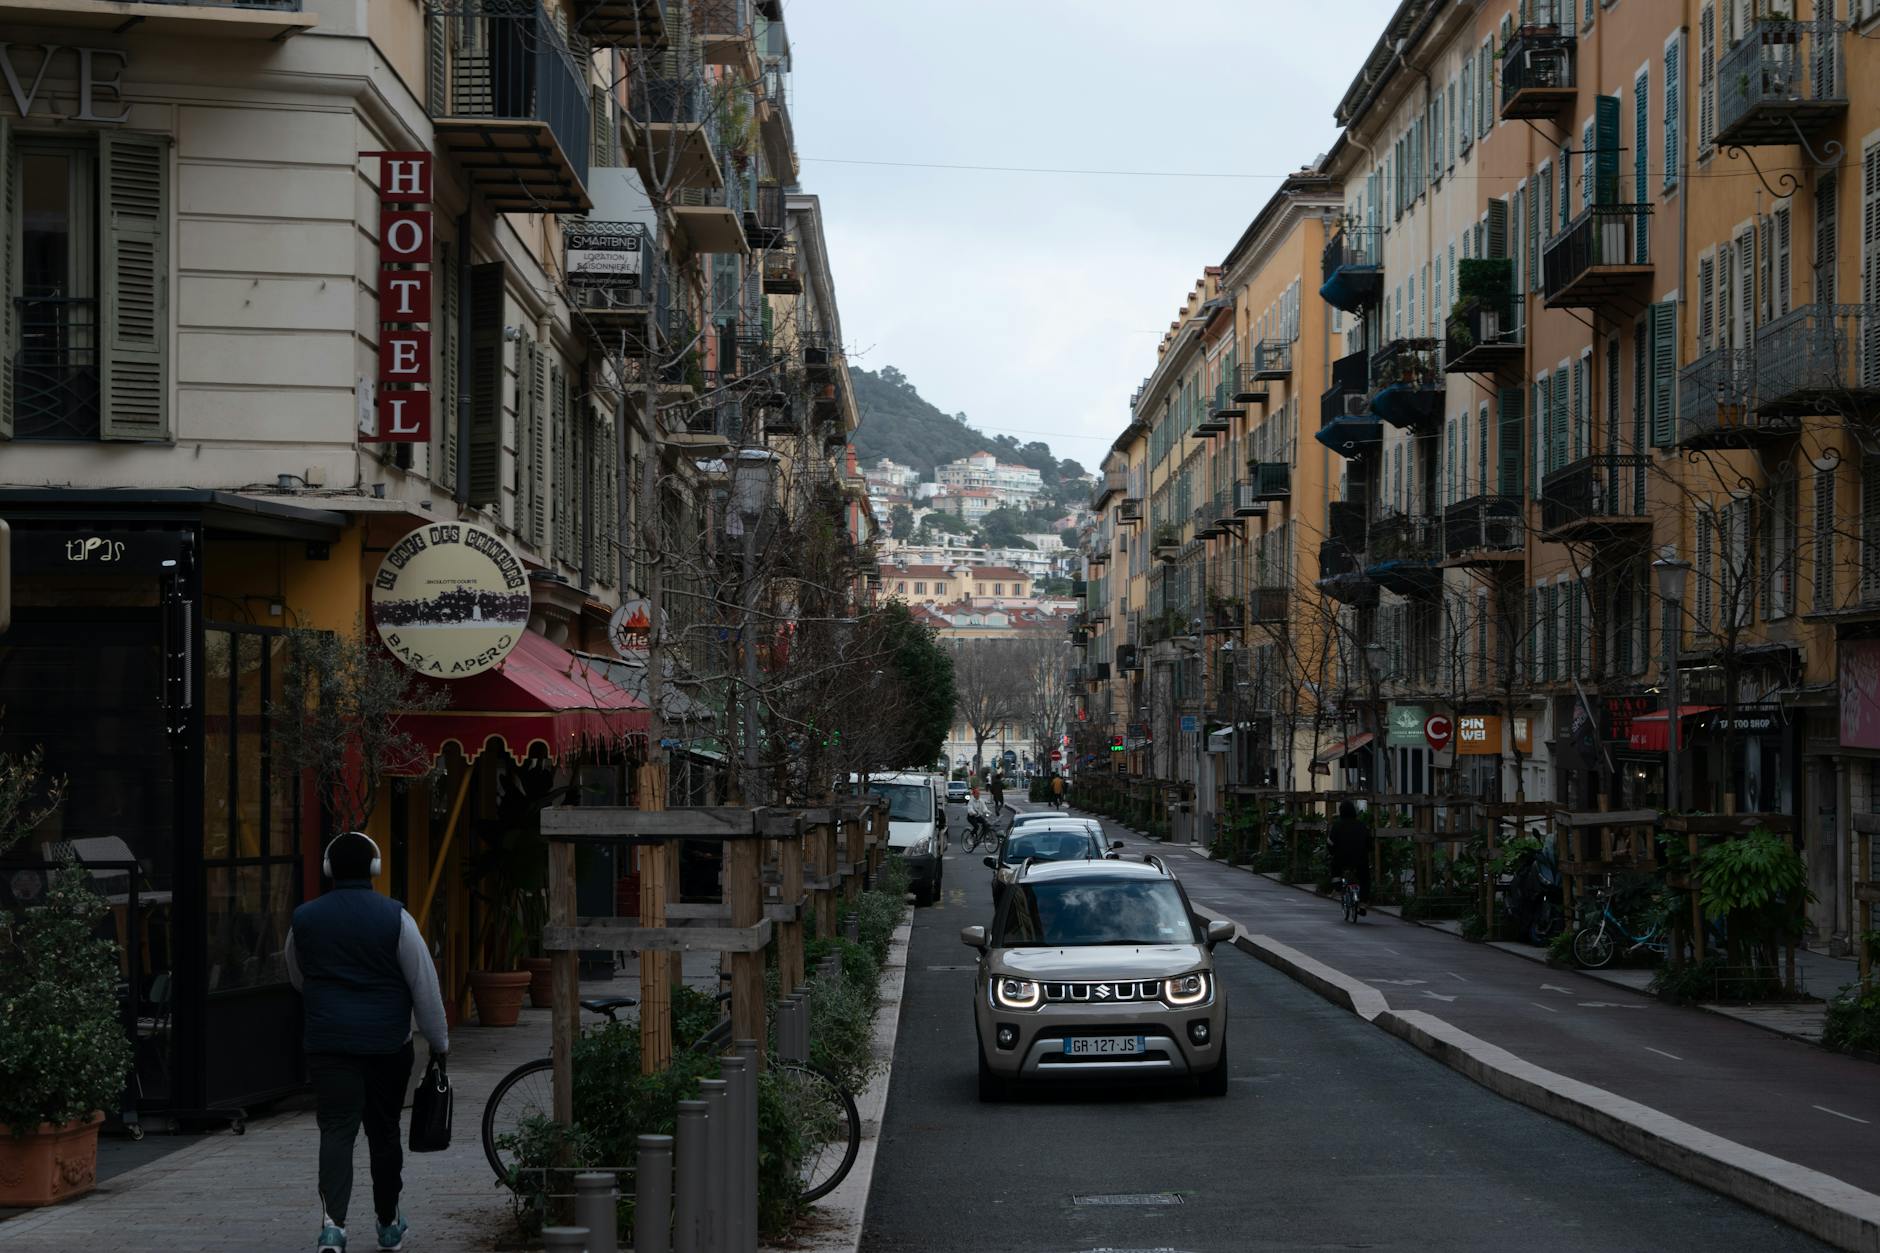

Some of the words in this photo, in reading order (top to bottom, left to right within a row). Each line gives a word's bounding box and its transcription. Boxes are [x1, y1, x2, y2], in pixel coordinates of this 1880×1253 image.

[583, 253, 625, 261] LOCATION
[387, 160, 424, 434] HOTEL
[377, 570, 397, 590] LE
[390, 535, 425, 567] CAFE
[431, 527, 459, 544] DES
[466, 530, 523, 588] CHINEURS
[386, 633, 424, 669] BAR
[451, 634, 512, 672] APERO
[1461, 718, 1484, 729] PIN
[1720, 719, 1749, 728] TATOO
[1461, 729, 1486, 741] WEI
